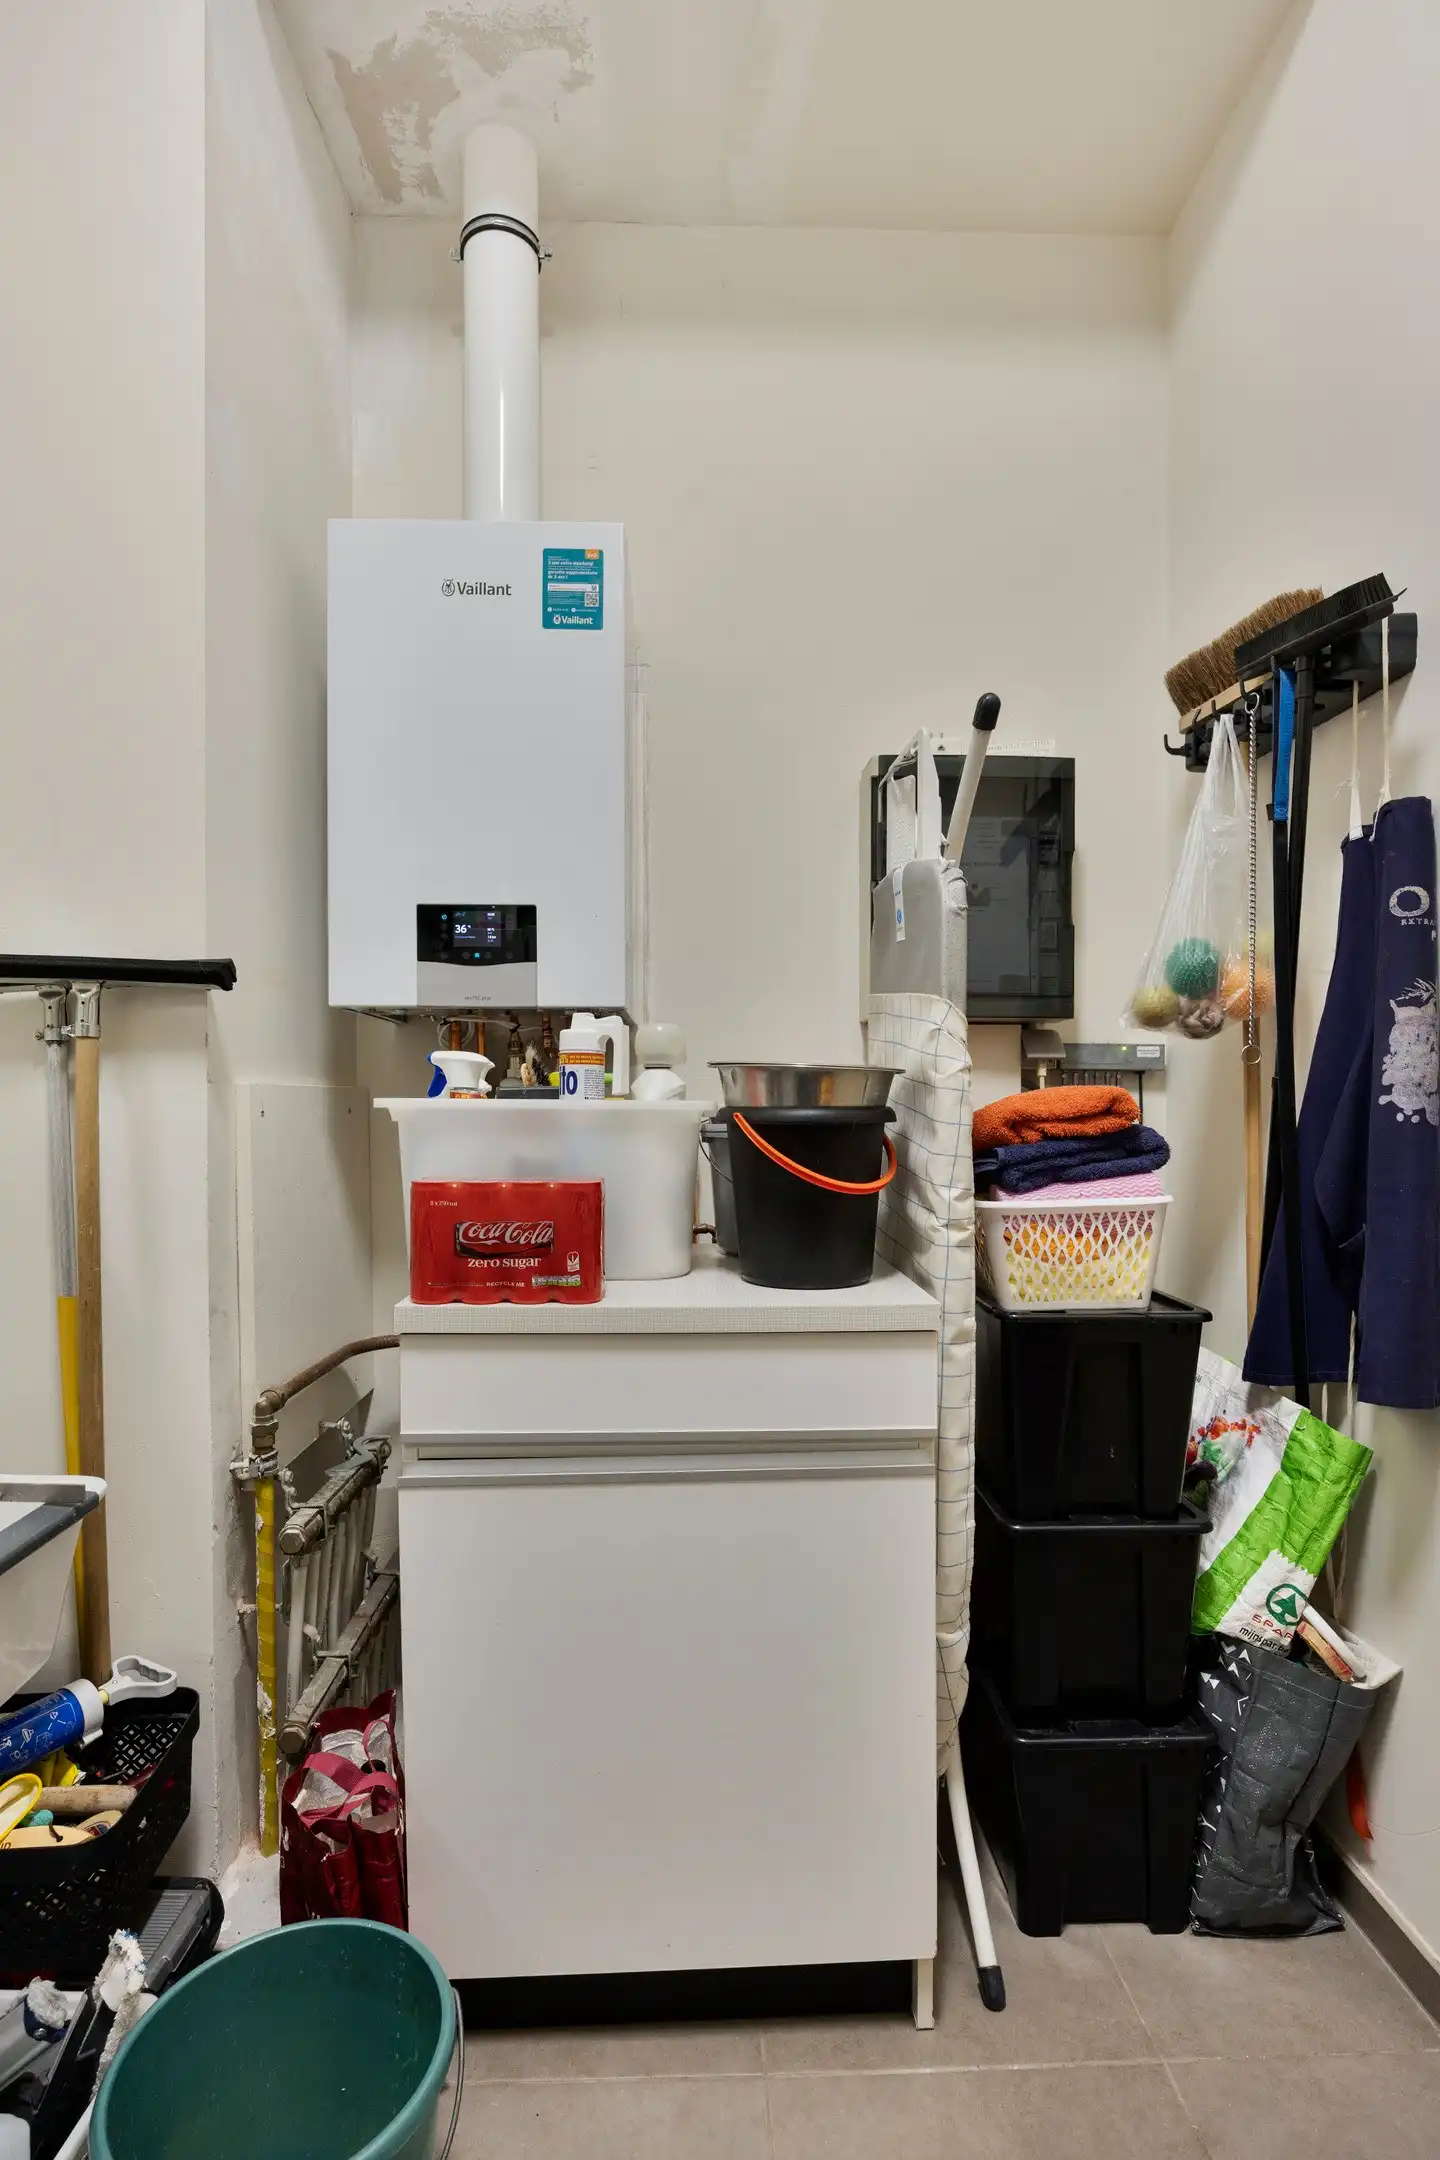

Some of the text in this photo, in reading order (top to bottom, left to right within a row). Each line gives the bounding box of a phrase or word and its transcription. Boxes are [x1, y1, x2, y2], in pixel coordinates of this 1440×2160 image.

[456, 581, 512, 596] Vaillant
[561, 615, 594, 625] Vaillant
[467, 1257, 542, 1269] zero sugar
